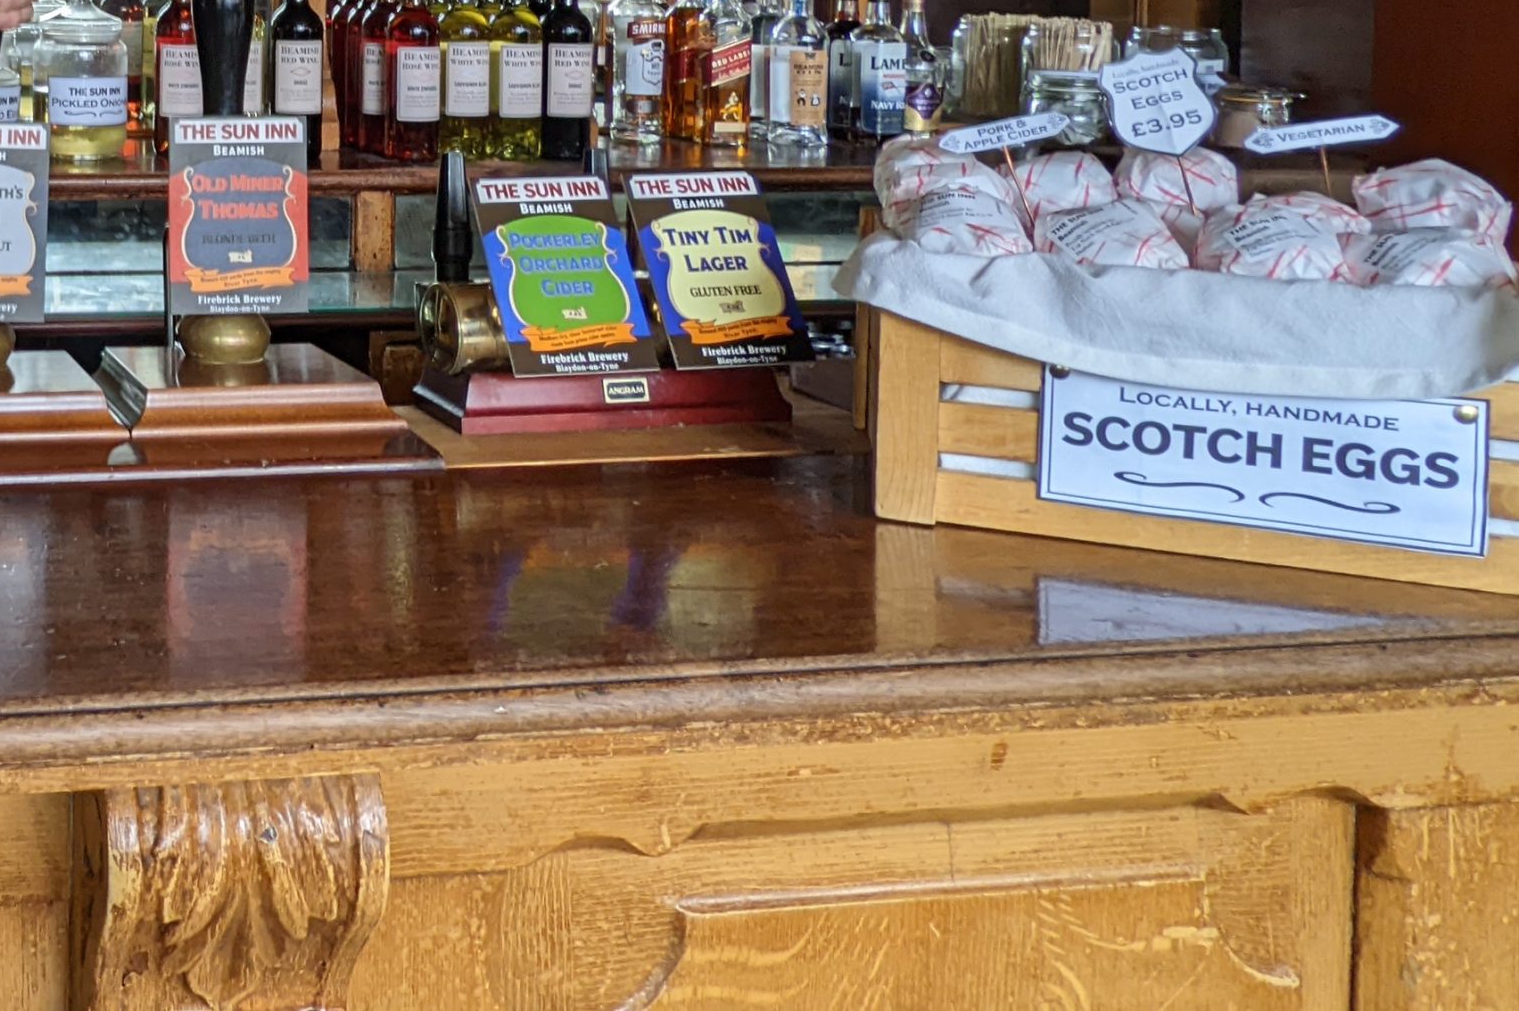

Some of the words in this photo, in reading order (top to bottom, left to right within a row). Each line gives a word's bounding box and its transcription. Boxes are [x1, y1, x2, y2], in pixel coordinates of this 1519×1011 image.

[711, 57, 729, 69] RED
[1112, 68, 1189, 94] SCOTCH
[68, 87, 87, 96] THE
[89, 87, 108, 96] SUN
[109, 87, 121, 96] INN
[1130, 90, 1184, 110] EGGS
[51, 97, 98, 108] PICKLED
[870, 99, 894, 110] NAVY
[179, 124, 216, 140] THE
[221, 123, 260, 140] SUN
[265, 123, 298, 139] INN
[977, 123, 1012, 137] PORK
[1016, 119, 1026, 128] &
[1131, 109, 1203, 138] £3.95
[7, 128, 42, 146] INN
[964, 135, 1005, 150] APPLE
[1007, 126, 1048, 141] CIDER
[1276, 123, 1365, 142] VEGETARIAN
[213, 145, 265, 156] BEAMISH
[191, 175, 228, 192] OLD
[230, 174, 283, 192] MINER
[482, 184, 520, 199] THE
[524, 183, 563, 198] SUN
[567, 181, 601, 196] INN
[635, 179, 673, 194] THE
[675, 178, 715, 193] SUN
[718, 177, 751, 191] INN
[198, 199, 279, 220] THOMAS
[519, 202, 573, 214] BEAMISH
[673, 198, 725, 210] BEAMISH
[509, 233, 600, 249] POCKERLEY
[662, 228, 711, 246] TINY
[713, 226, 753, 243] TIM
[519, 256, 603, 274] ORCHARD
[684, 254, 749, 273] LAGER
[541, 279, 594, 296] CIDER
[690, 285, 733, 298] GLUTEN
[733, 284, 762, 296] FREE
[198, 295, 241, 305] Firebrick
[243, 294, 282, 305] Brewery
[540, 352, 587, 364] Firebrick
[588, 351, 629, 363] Brewery
[702, 346, 747, 357] Firebrick
[747, 345, 787, 356] Brewery
[607, 386, 644, 395] ANGRAM
[1119, 385, 1239, 417] LOCALLY,
[1245, 401, 1400, 432] HANDMADE
[1061, 410, 1284, 470] SCOTCH
[1301, 436, 1461, 489] EGGS
